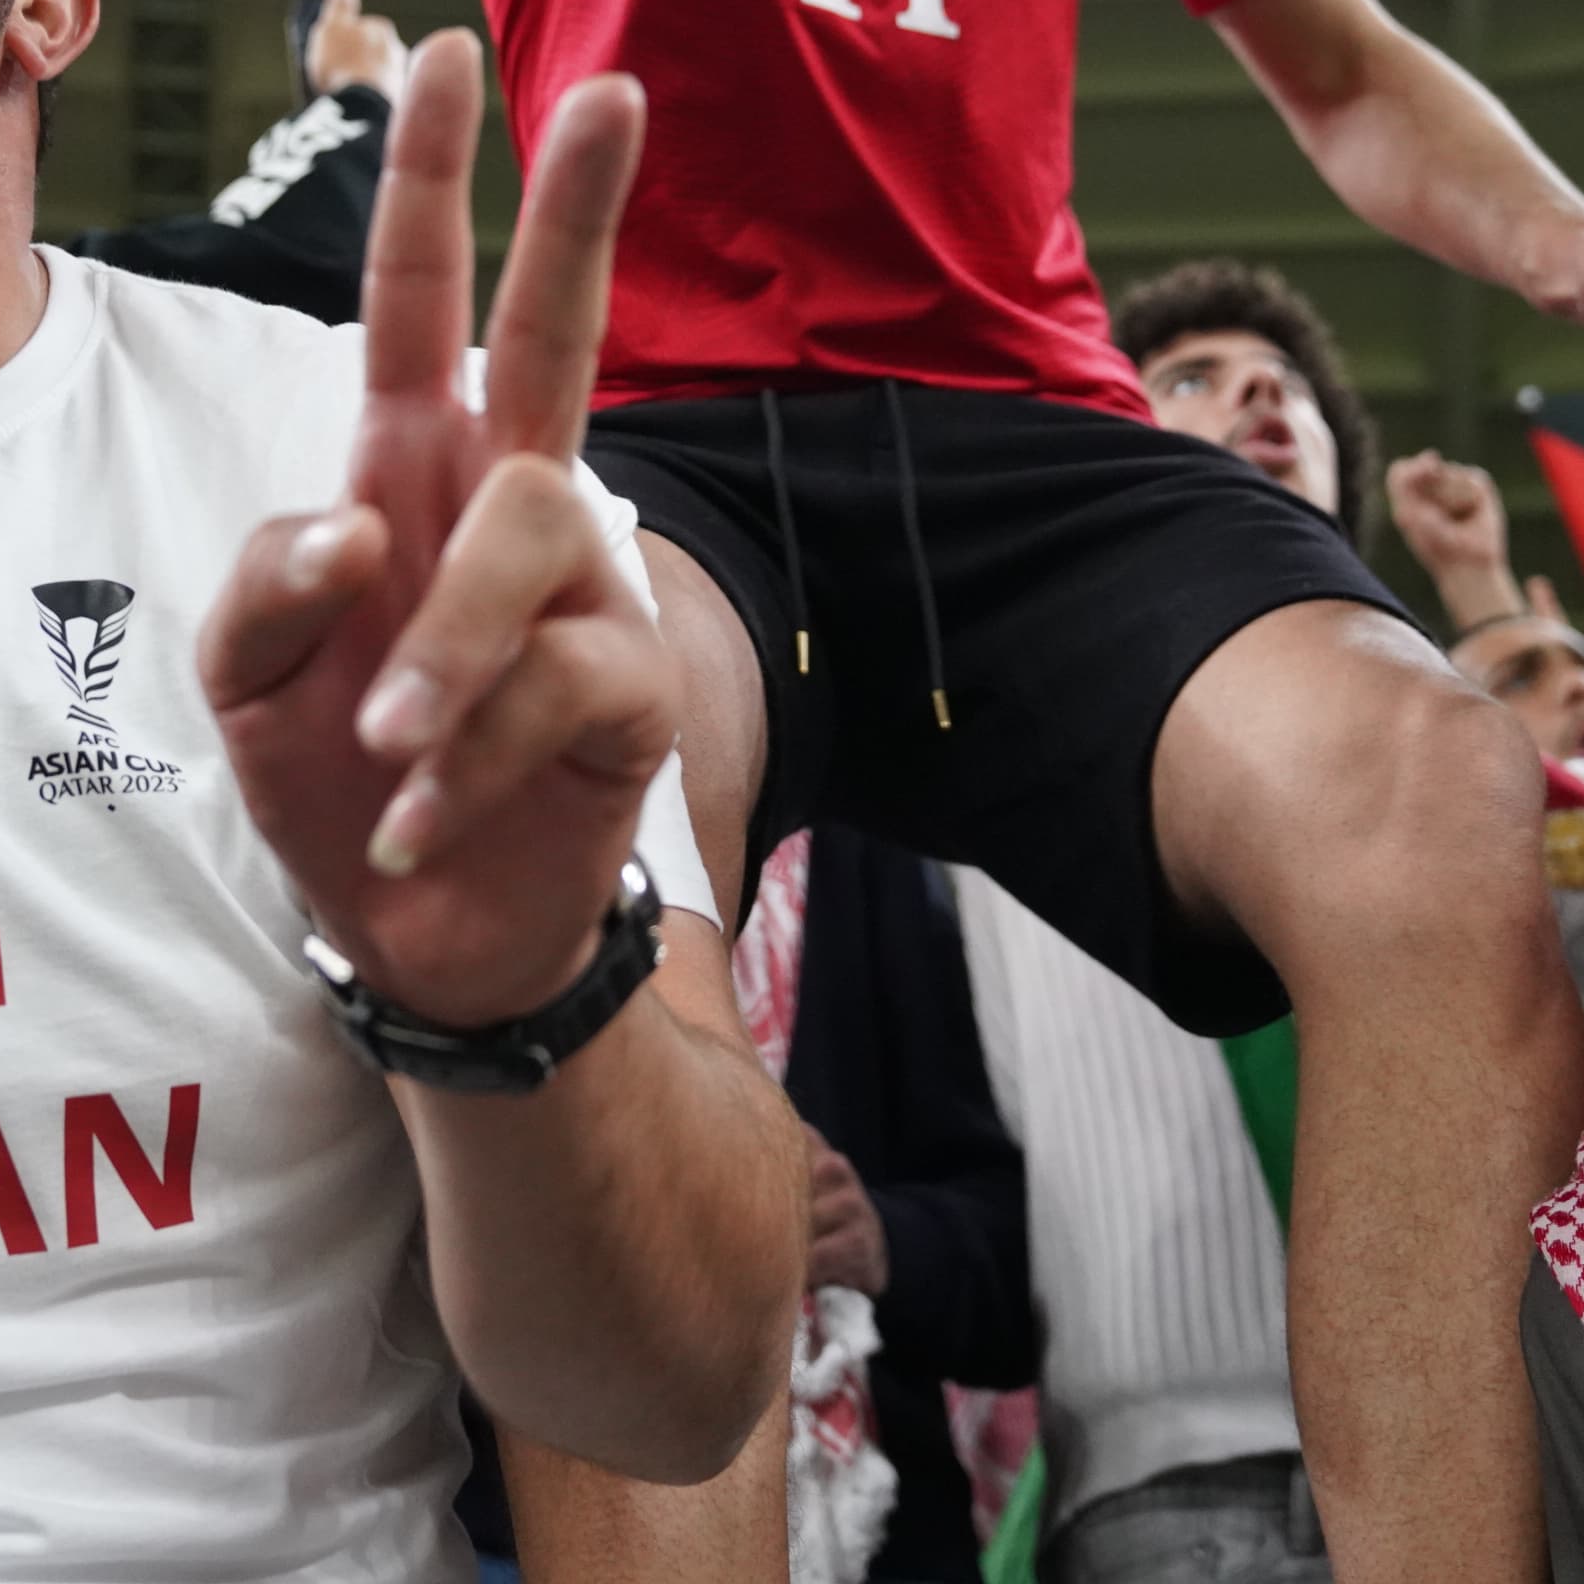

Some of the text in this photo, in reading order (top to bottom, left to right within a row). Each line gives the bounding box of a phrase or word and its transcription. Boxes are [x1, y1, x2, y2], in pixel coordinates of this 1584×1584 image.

[77, 730, 120, 748] AFC
[28, 750, 183, 780] ASIAN CUP
[38, 775, 114, 805] QATAR
